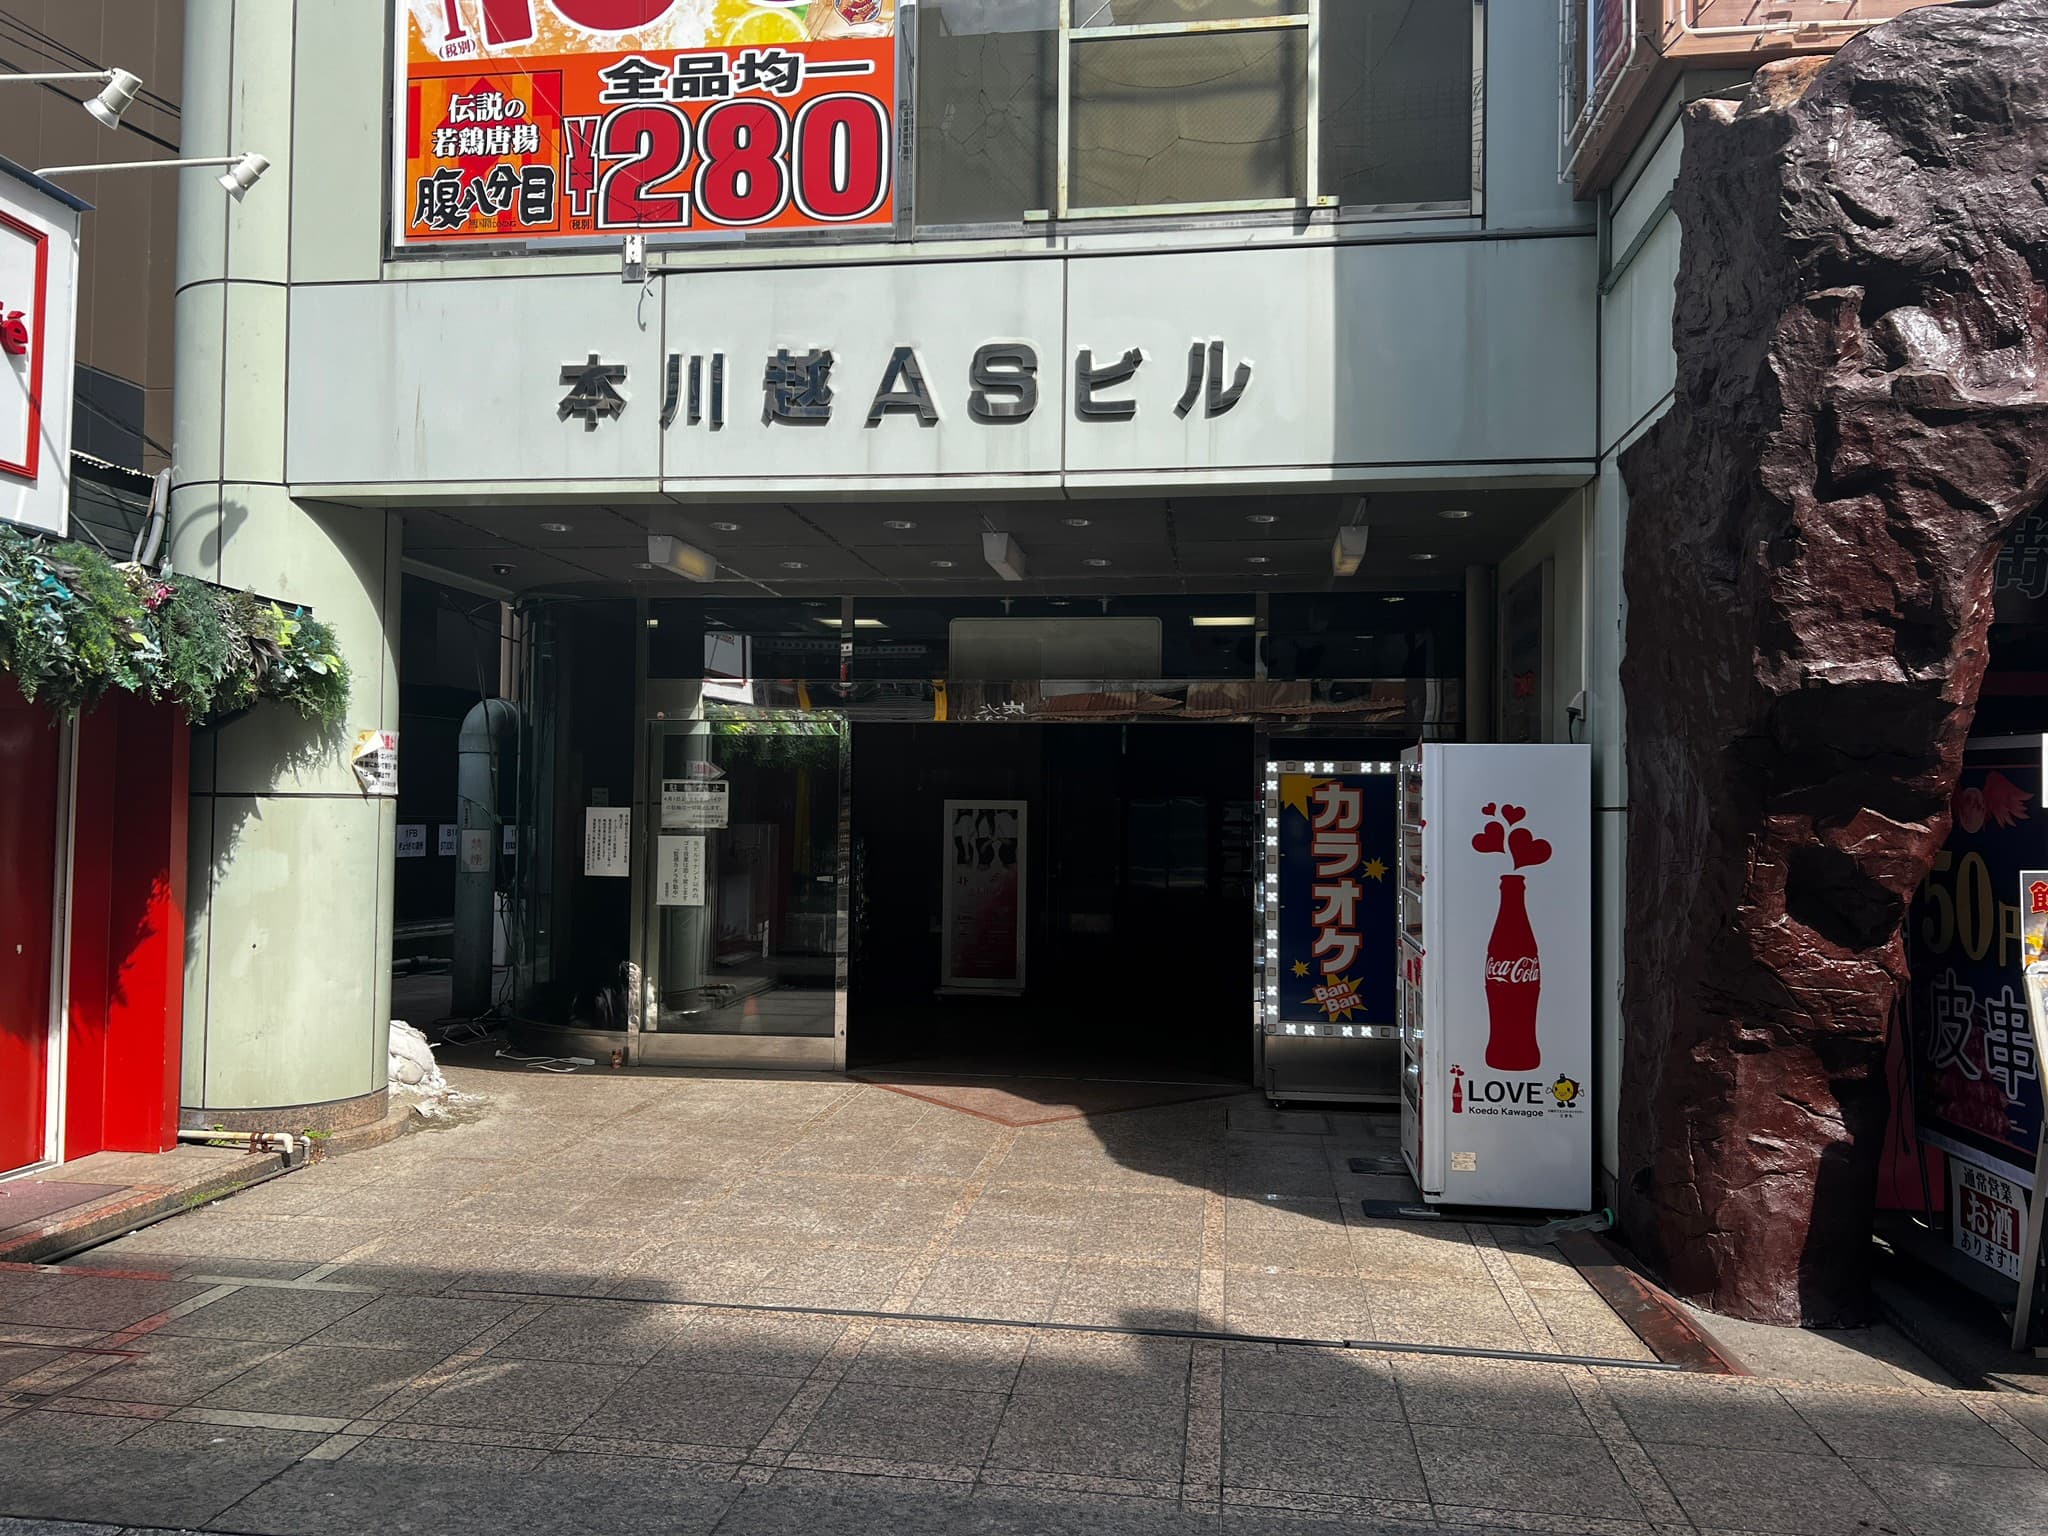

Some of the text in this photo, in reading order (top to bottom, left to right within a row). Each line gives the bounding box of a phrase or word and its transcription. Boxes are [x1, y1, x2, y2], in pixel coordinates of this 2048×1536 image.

[438, 39, 476, 58] (税別)
[601, 51, 872, 99] 全品均一
[448, 92, 525, 123] 伝説の
[432, 124, 539, 157] 若鶏唐揚
[412, 164, 556, 230] 腹八分目
[558, 341, 1253, 432] 本川越ASビル
[1311, 781, 1364, 975] カラオケ
[1486, 956, 1540, 984] Coca-Cola
[1314, 982, 1351, 1002] Ban
[1325, 993, 1361, 1014] Ban
[1927, 968, 2038, 1101] 皮串
[1468, 1080, 1544, 1104] LOVE
[1468, 1106, 1499, 1116] Koedo
[1501, 1107, 1544, 1118] Kawagoe
[1963, 1167, 2013, 1204] 通常営業
[1966, 1190, 2014, 1250] お酒
